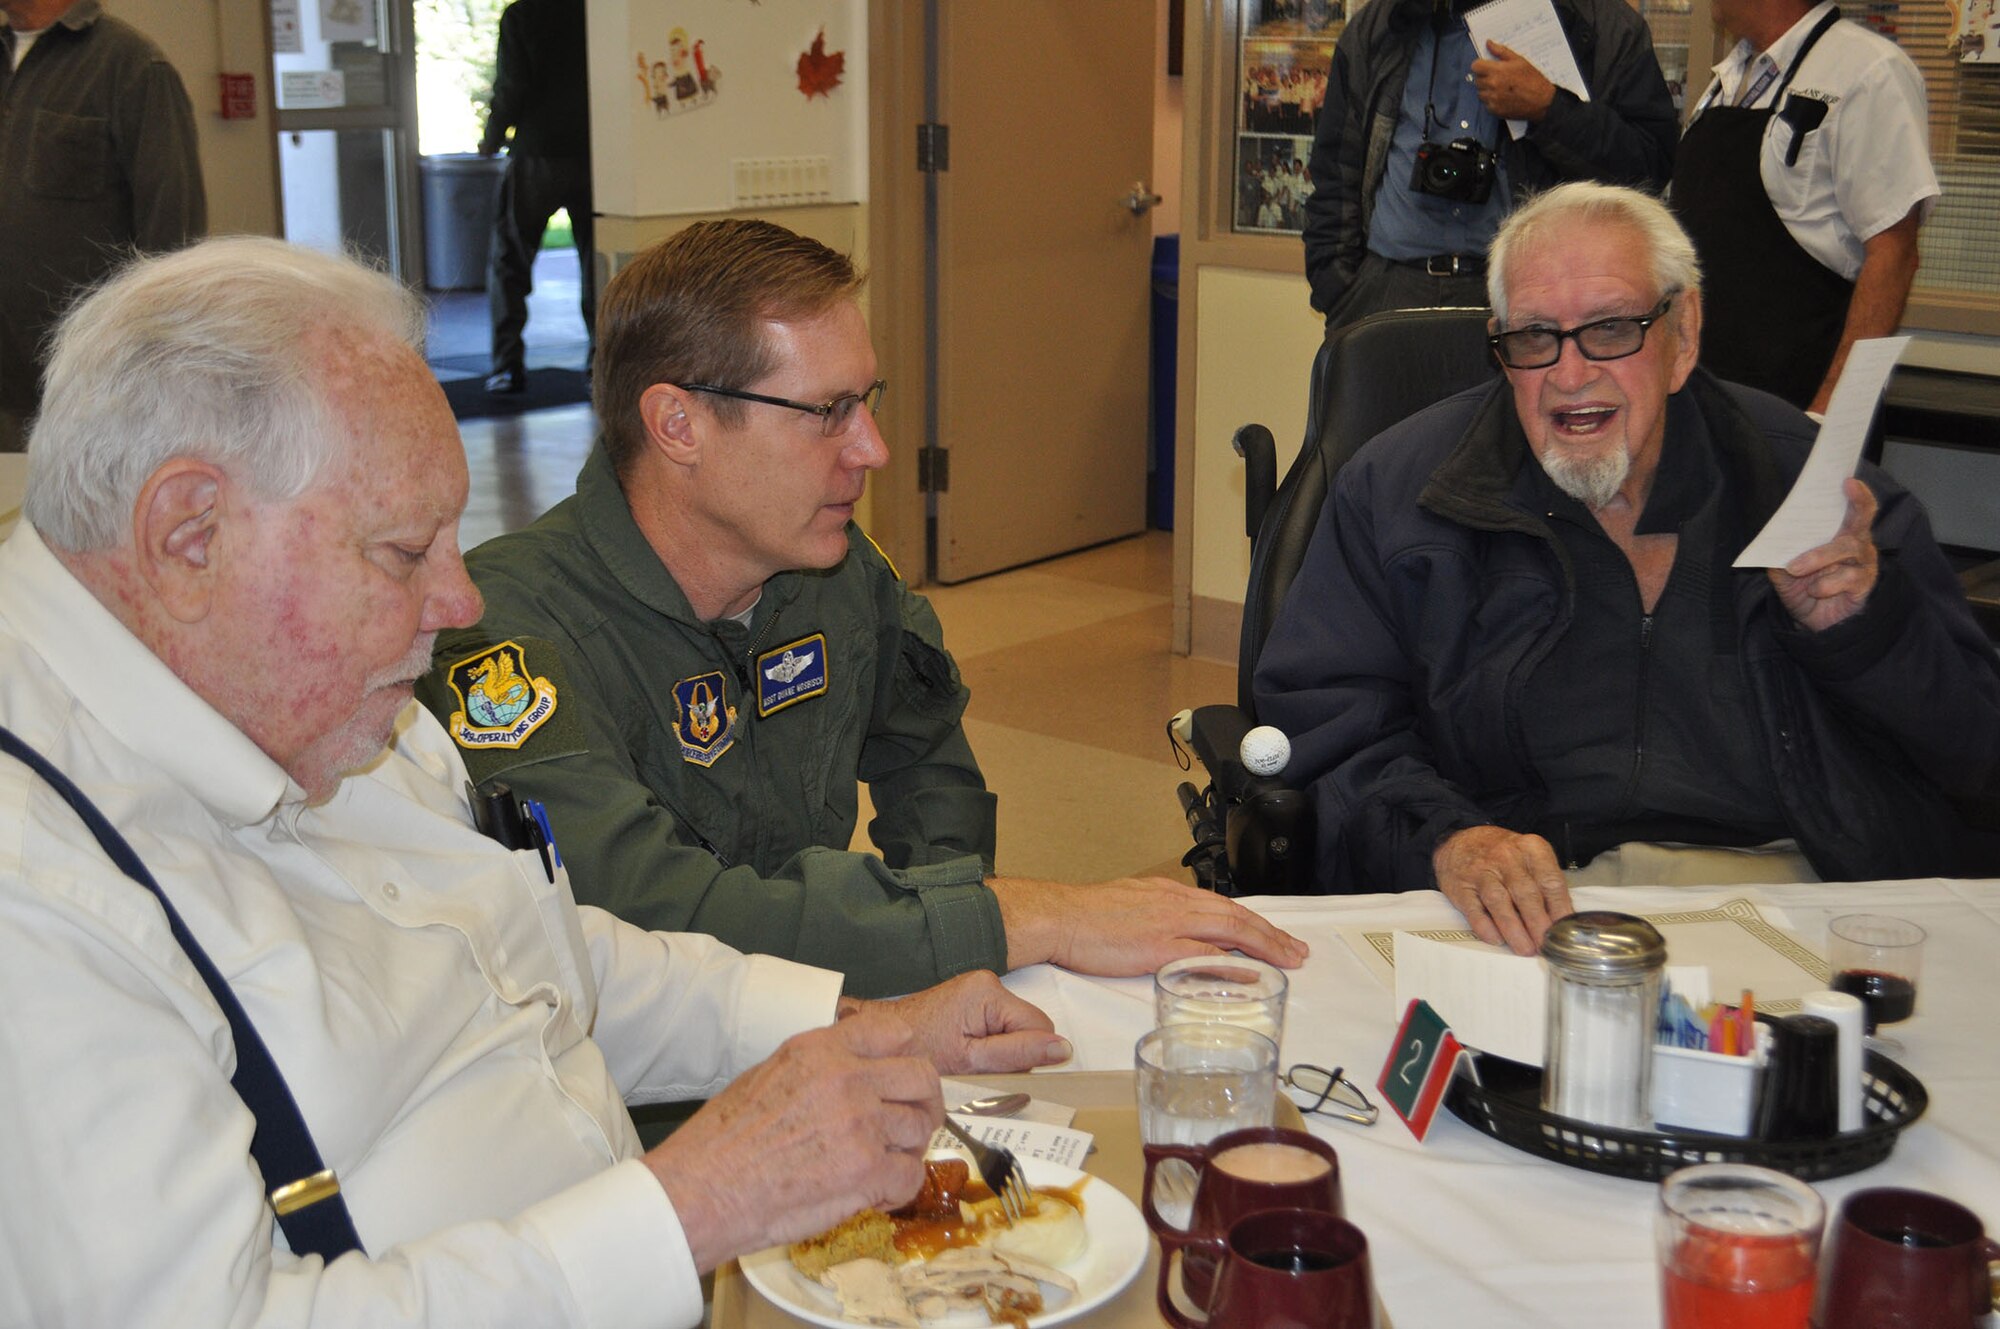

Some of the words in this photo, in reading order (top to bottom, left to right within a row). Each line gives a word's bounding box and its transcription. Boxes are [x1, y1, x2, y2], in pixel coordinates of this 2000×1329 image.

[478, 720, 530, 743] OPERATIONS
[527, 696, 551, 723] GROUP
[1400, 1039, 1422, 1085] 2
